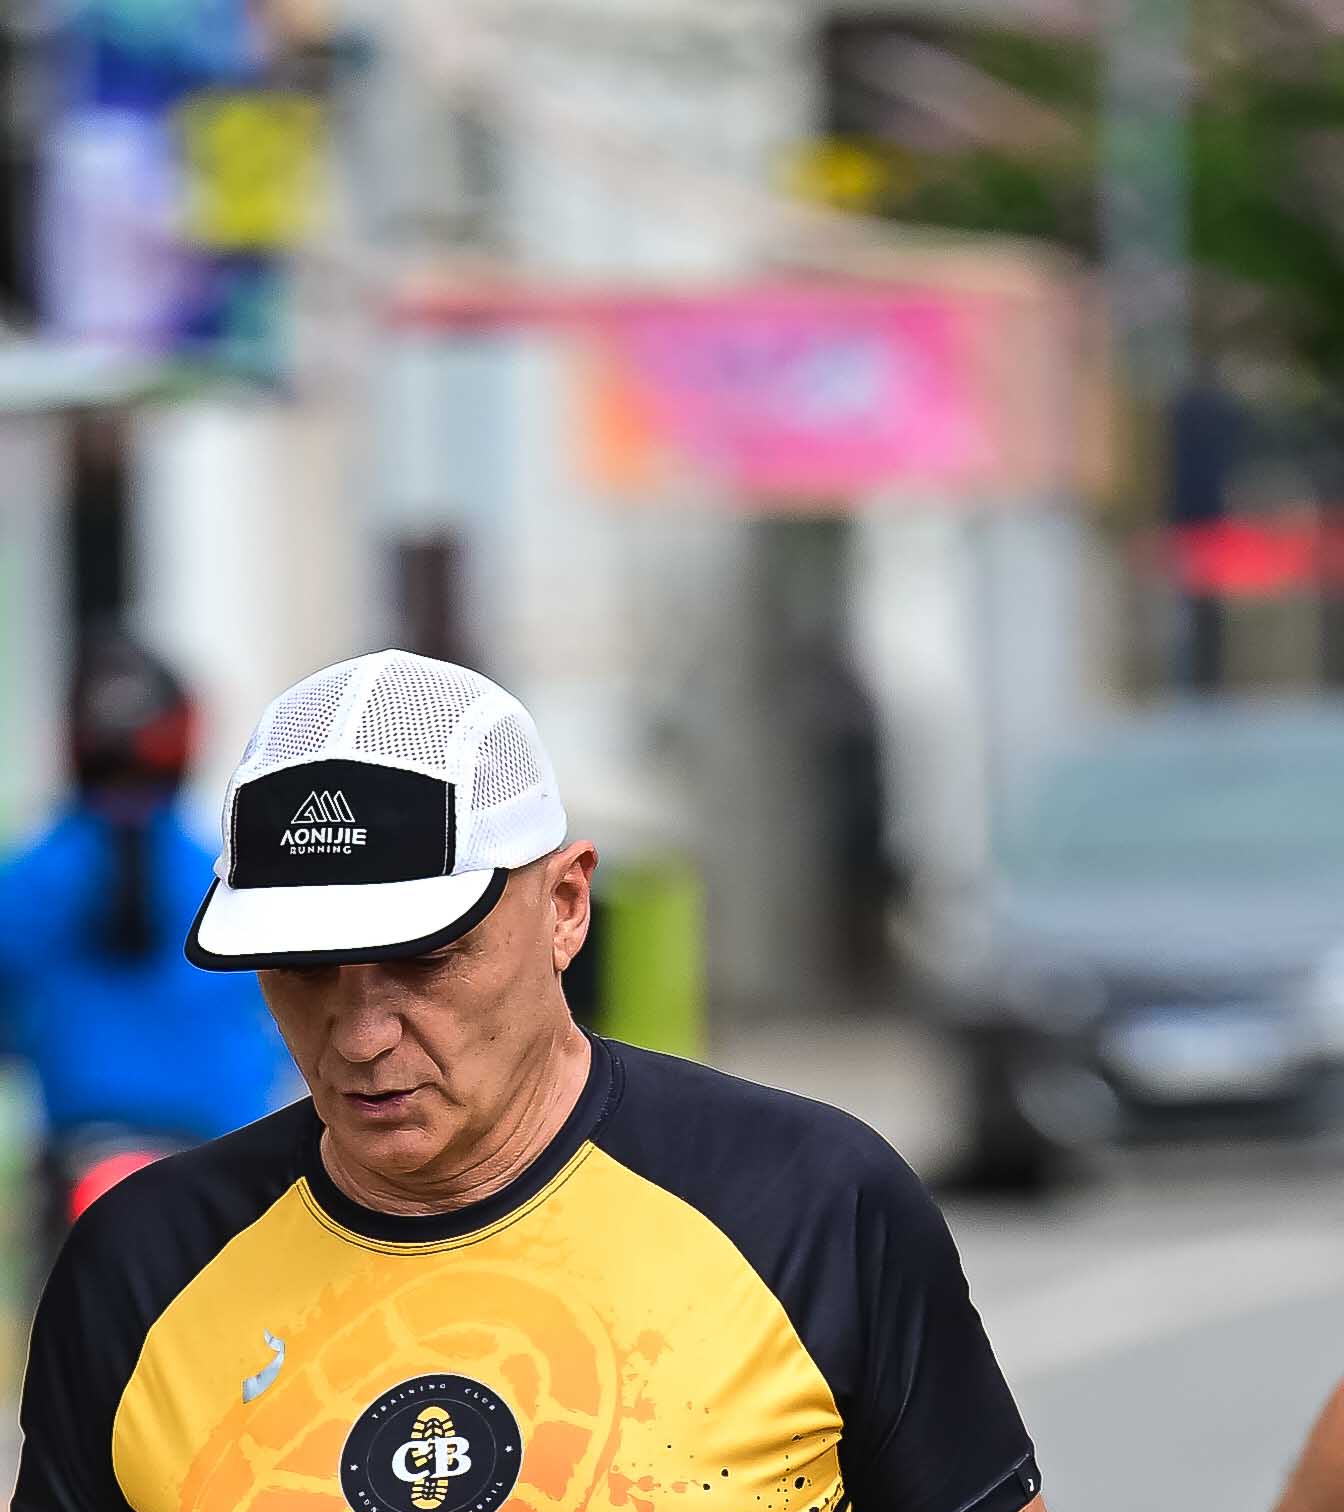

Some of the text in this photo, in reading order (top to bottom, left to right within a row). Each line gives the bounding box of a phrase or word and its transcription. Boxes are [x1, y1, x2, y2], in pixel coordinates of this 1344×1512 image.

[279, 827, 368, 846] AONIJIE
[289, 845, 353, 855] RUNNING
[391, 1436, 472, 1483] CB
